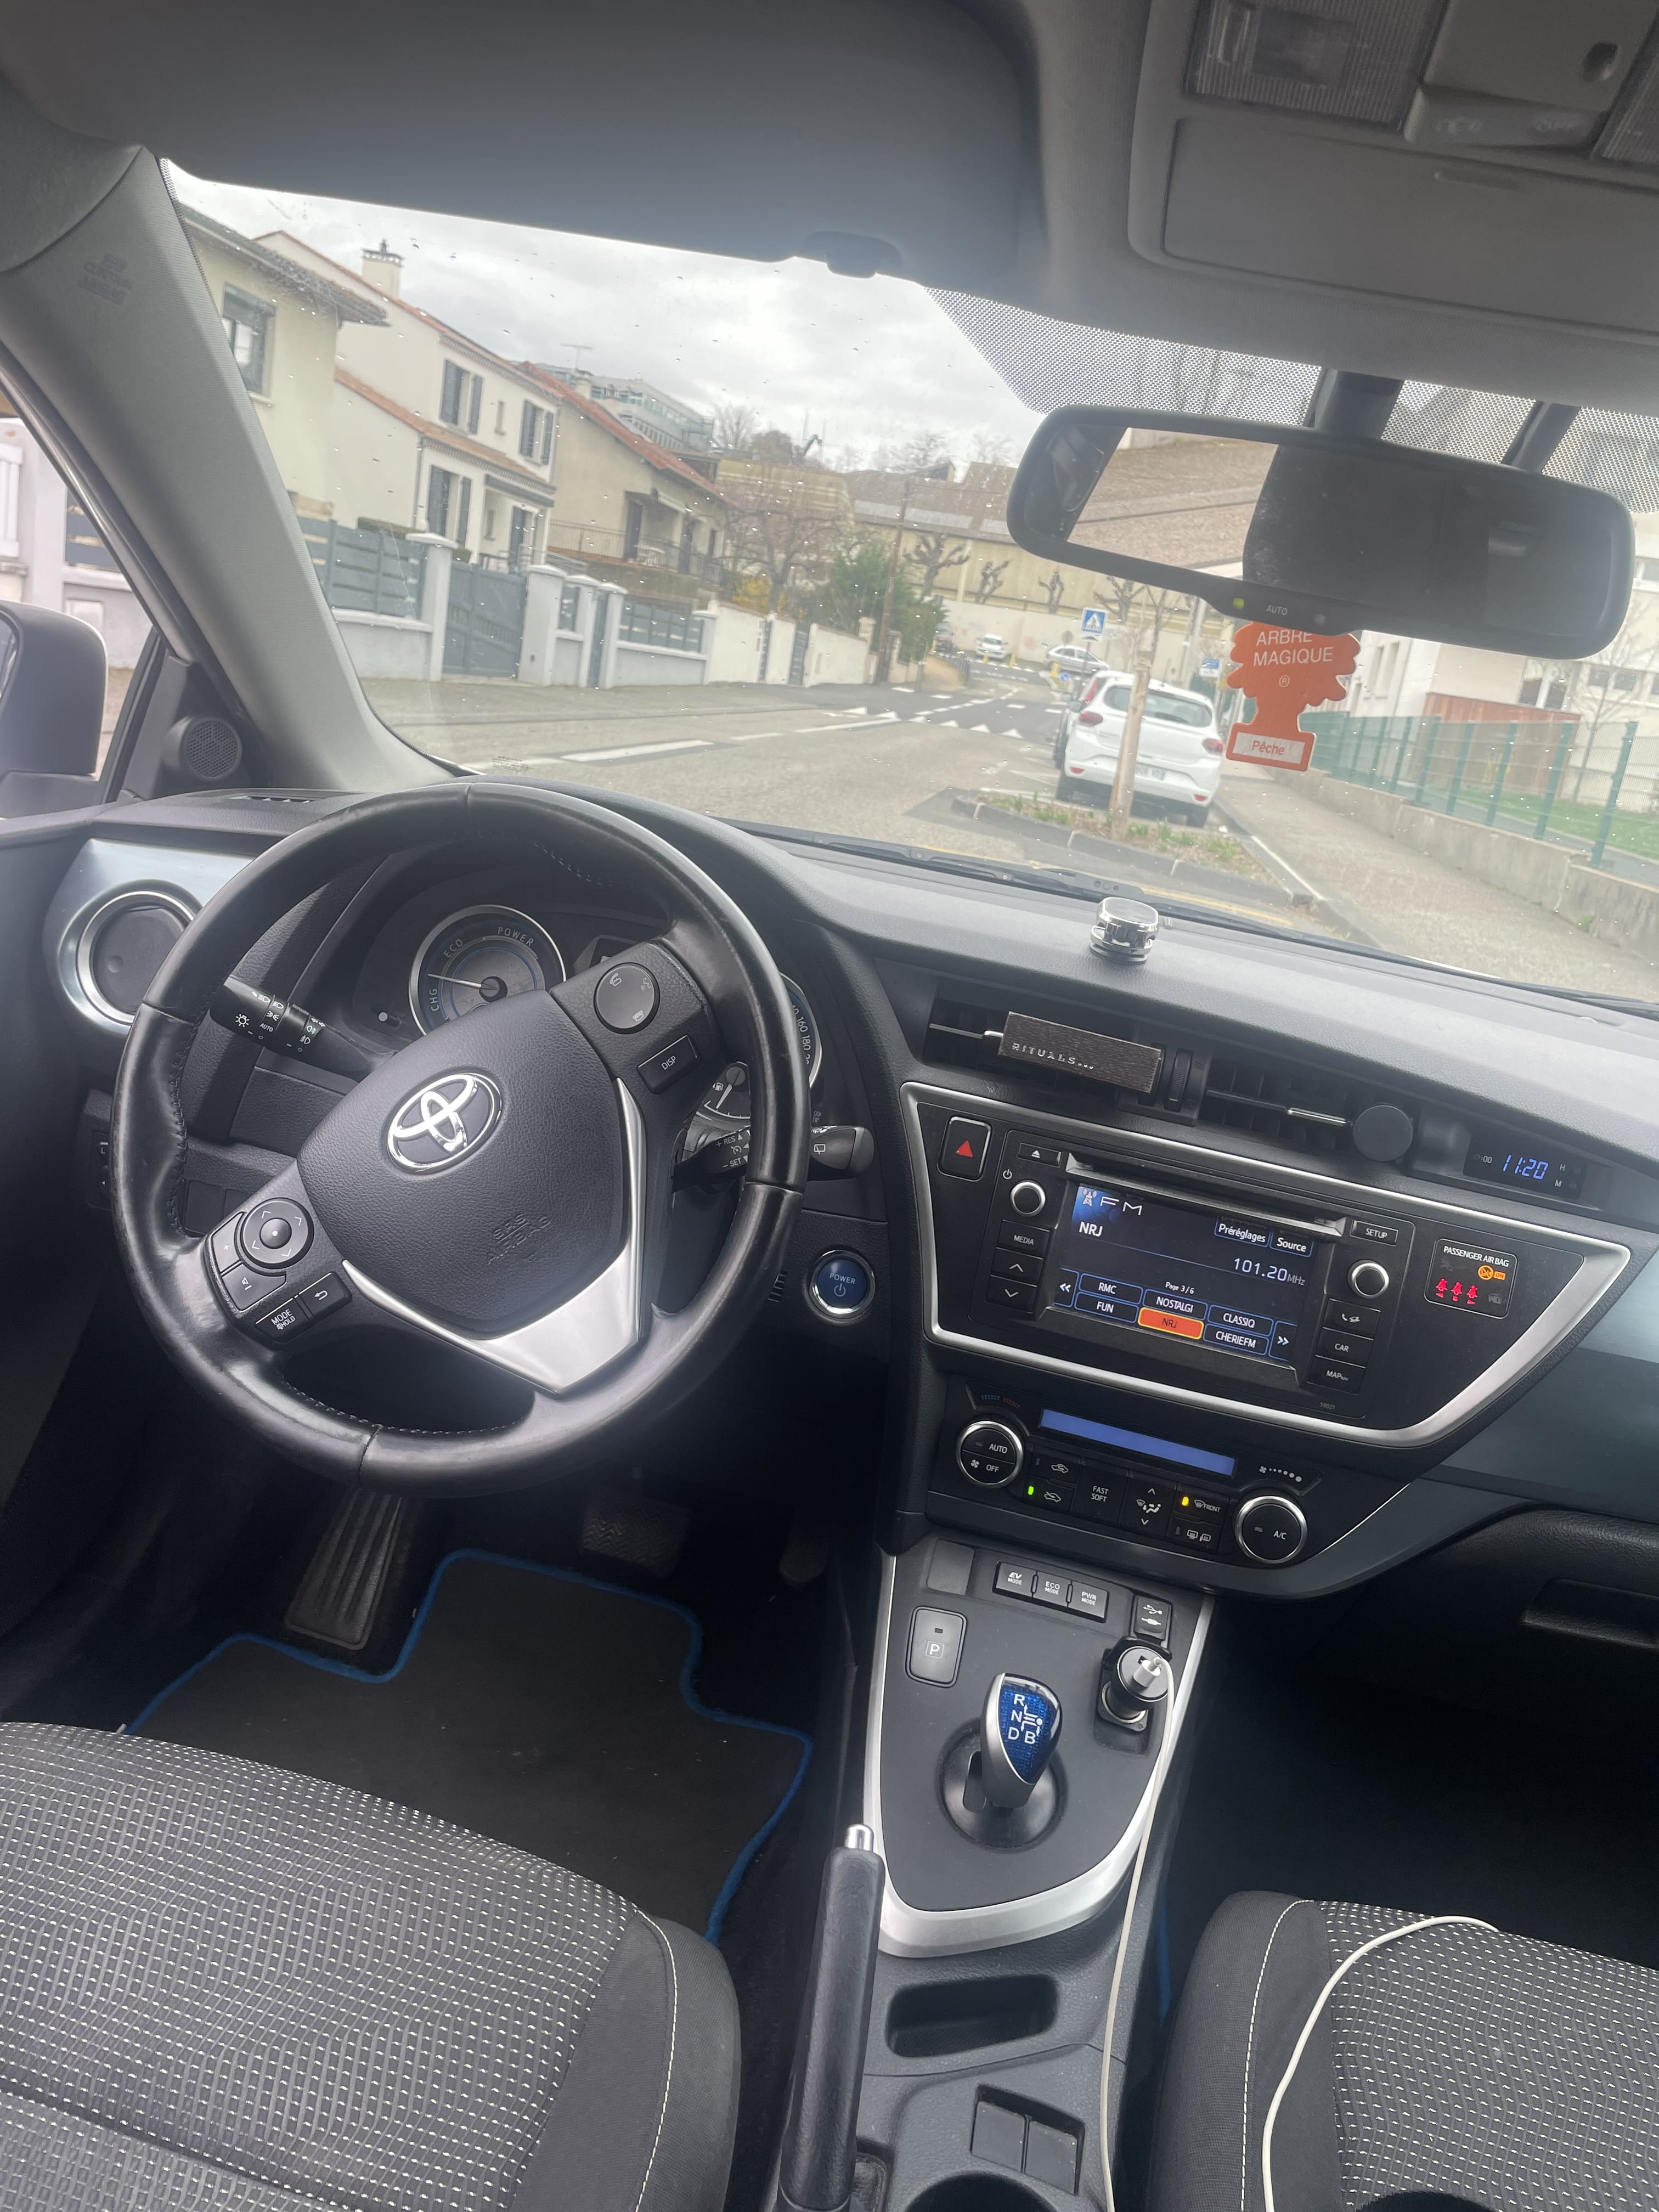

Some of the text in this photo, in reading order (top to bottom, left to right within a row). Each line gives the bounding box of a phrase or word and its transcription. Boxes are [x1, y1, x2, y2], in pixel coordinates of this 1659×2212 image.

[1266, 604, 1288, 616] AUTO
[1256, 630, 1313, 646] ARBRE
[1253, 646, 1334, 667] MAGIQUE
[1251, 740, 1285, 755] Pêche
[497, 927, 534, 947] POWER
[443, 939, 463, 958] ECO
[429, 988, 439, 1012] CHG
[259, 1023, 274, 1032] AUTO
[797, 1017, 808, 1032] 160
[802, 1035, 811, 1051] 180
[661, 1056, 677, 1070] DISP
[723, 1137, 736, 1146] RES
[730, 1158, 742, 1167] SET
[1503, 1154, 1549, 1180] 11:20
[1100, 1196, 1143, 1216] FM
[1079, 1221, 1103, 1237] NRJ
[1218, 1223, 1267, 1243] Préréglages
[1365, 1228, 1387, 1239] SETUP
[1013, 1234, 1034, 1245] MEDIA
[1277, 1237, 1307, 1252] Source
[1443, 1246, 1510, 1267] PASSENGER AIR BAG
[830, 1273, 856, 1284] POWER
[1098, 1282, 1117, 1294] RMC
[1165, 1282, 1179, 1291] Page
[1096, 1301, 1114, 1313] FUN
[1156, 1296, 1194, 1313] NOSTALGI
[270, 1308, 292, 1325] MODE
[280, 1316, 296, 1328] HOLD
[1162, 1317, 1177, 1328] NRJ
[1223, 1313, 1255, 1328] CLASSIQ
[1216, 1331, 1256, 1348] CHERIEFM
[1334, 1343, 1350, 1352] CAR
[989, 1443, 1008, 1454] AUTO
[986, 1464, 1000, 1472] OFF
[1092, 1486, 1109, 1495] FAST
[1091, 1493, 1107, 1503] SOFT
[1203, 1504, 1221, 1513] FRONT
[1273, 1531, 1287, 1540] A/C
[1045, 1581, 1060, 1590] ECO
[1045, 1587, 1059, 1595] MODE
[1081, 1591, 1097, 1601] PWR
[1081, 1597, 1096, 1606] MODE
[929, 1643, 940, 1655] P
[1013, 1694, 1025, 1706] R
[1011, 1709, 1022, 1723] N
[1008, 1726, 1036, 1745] D B
